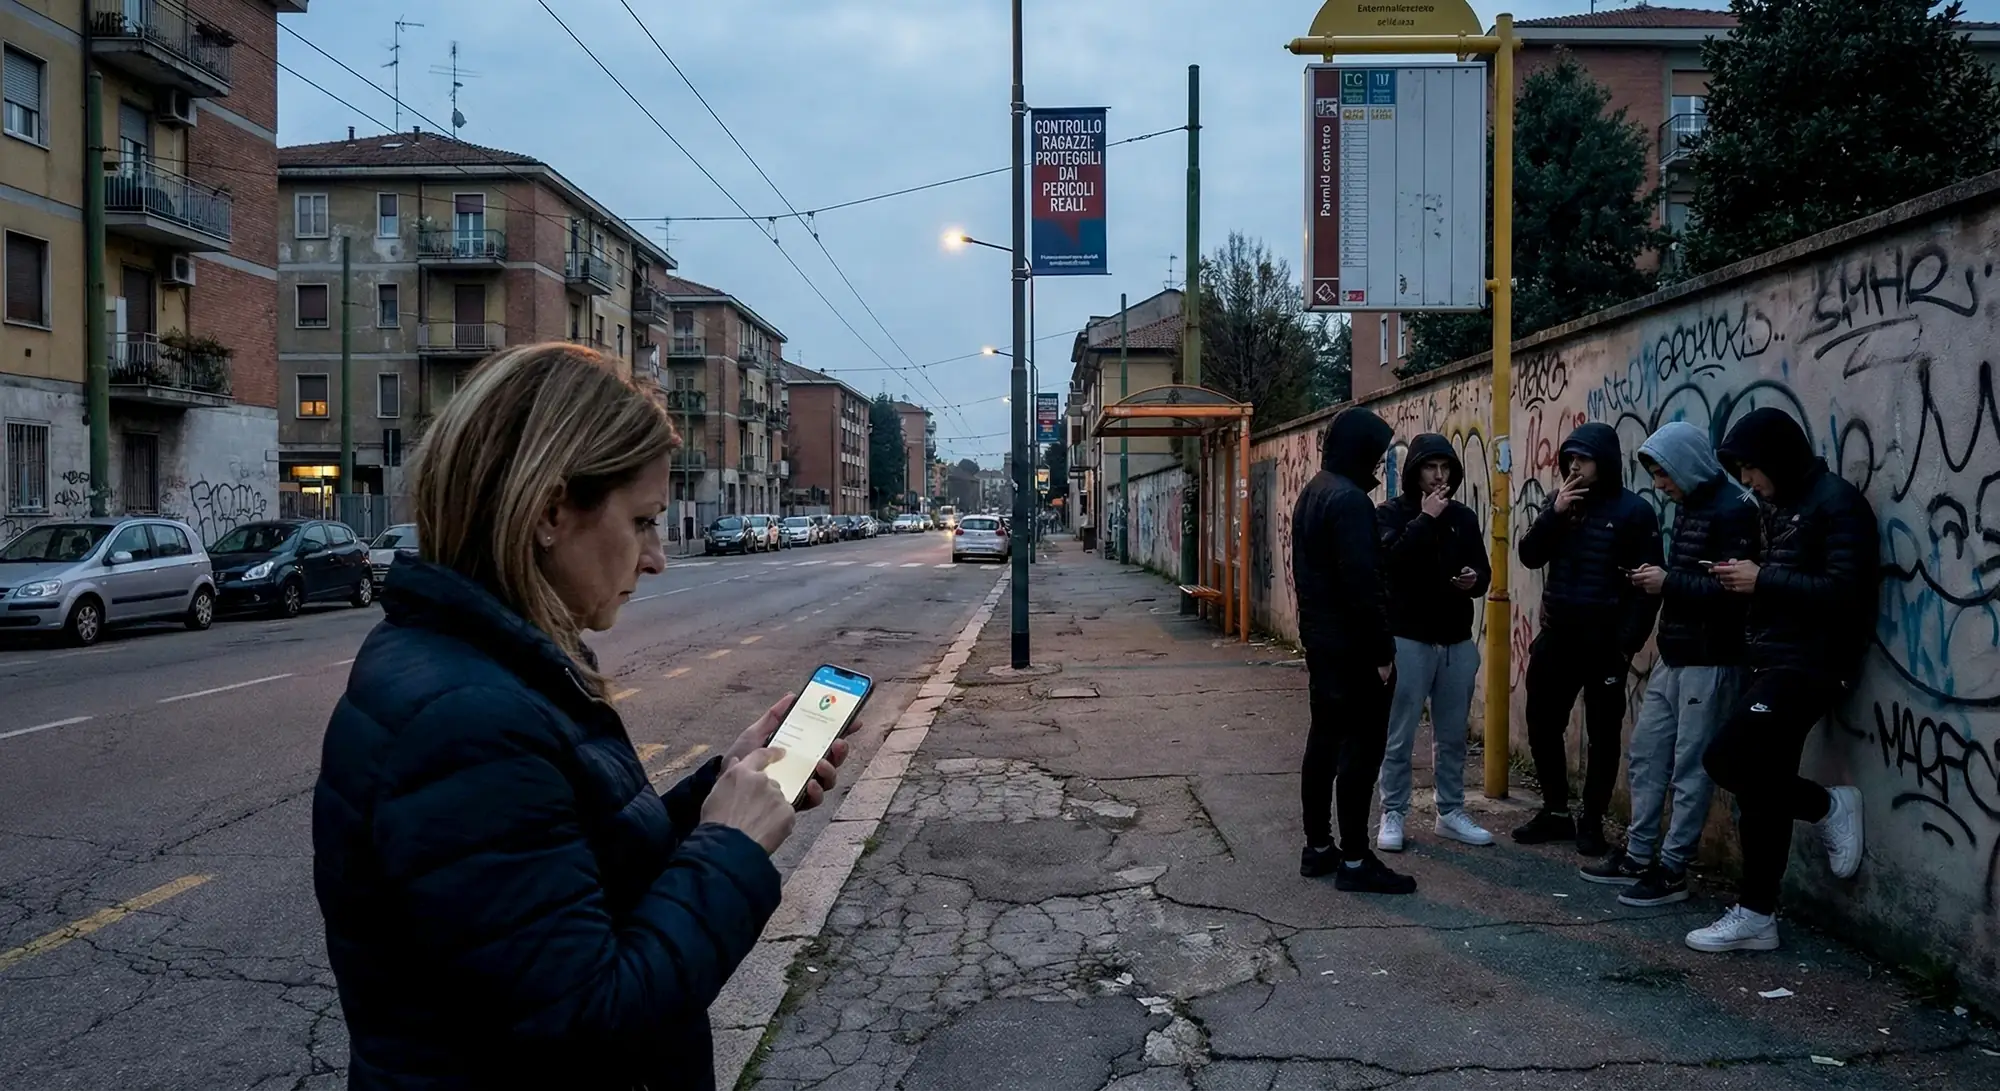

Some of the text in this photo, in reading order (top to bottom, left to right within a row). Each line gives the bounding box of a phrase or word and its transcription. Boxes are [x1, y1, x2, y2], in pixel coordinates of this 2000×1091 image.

[1035, 119, 1102, 134] CONTROLLO
[1042, 135, 1095, 150] RAGAZZI:
[1036, 151, 1102, 166] PROTEGGILI
[1059, 166, 1078, 181] DAI
[1042, 181, 1095, 197] PERICOLI
[1050, 197, 1087, 212] REALI.
